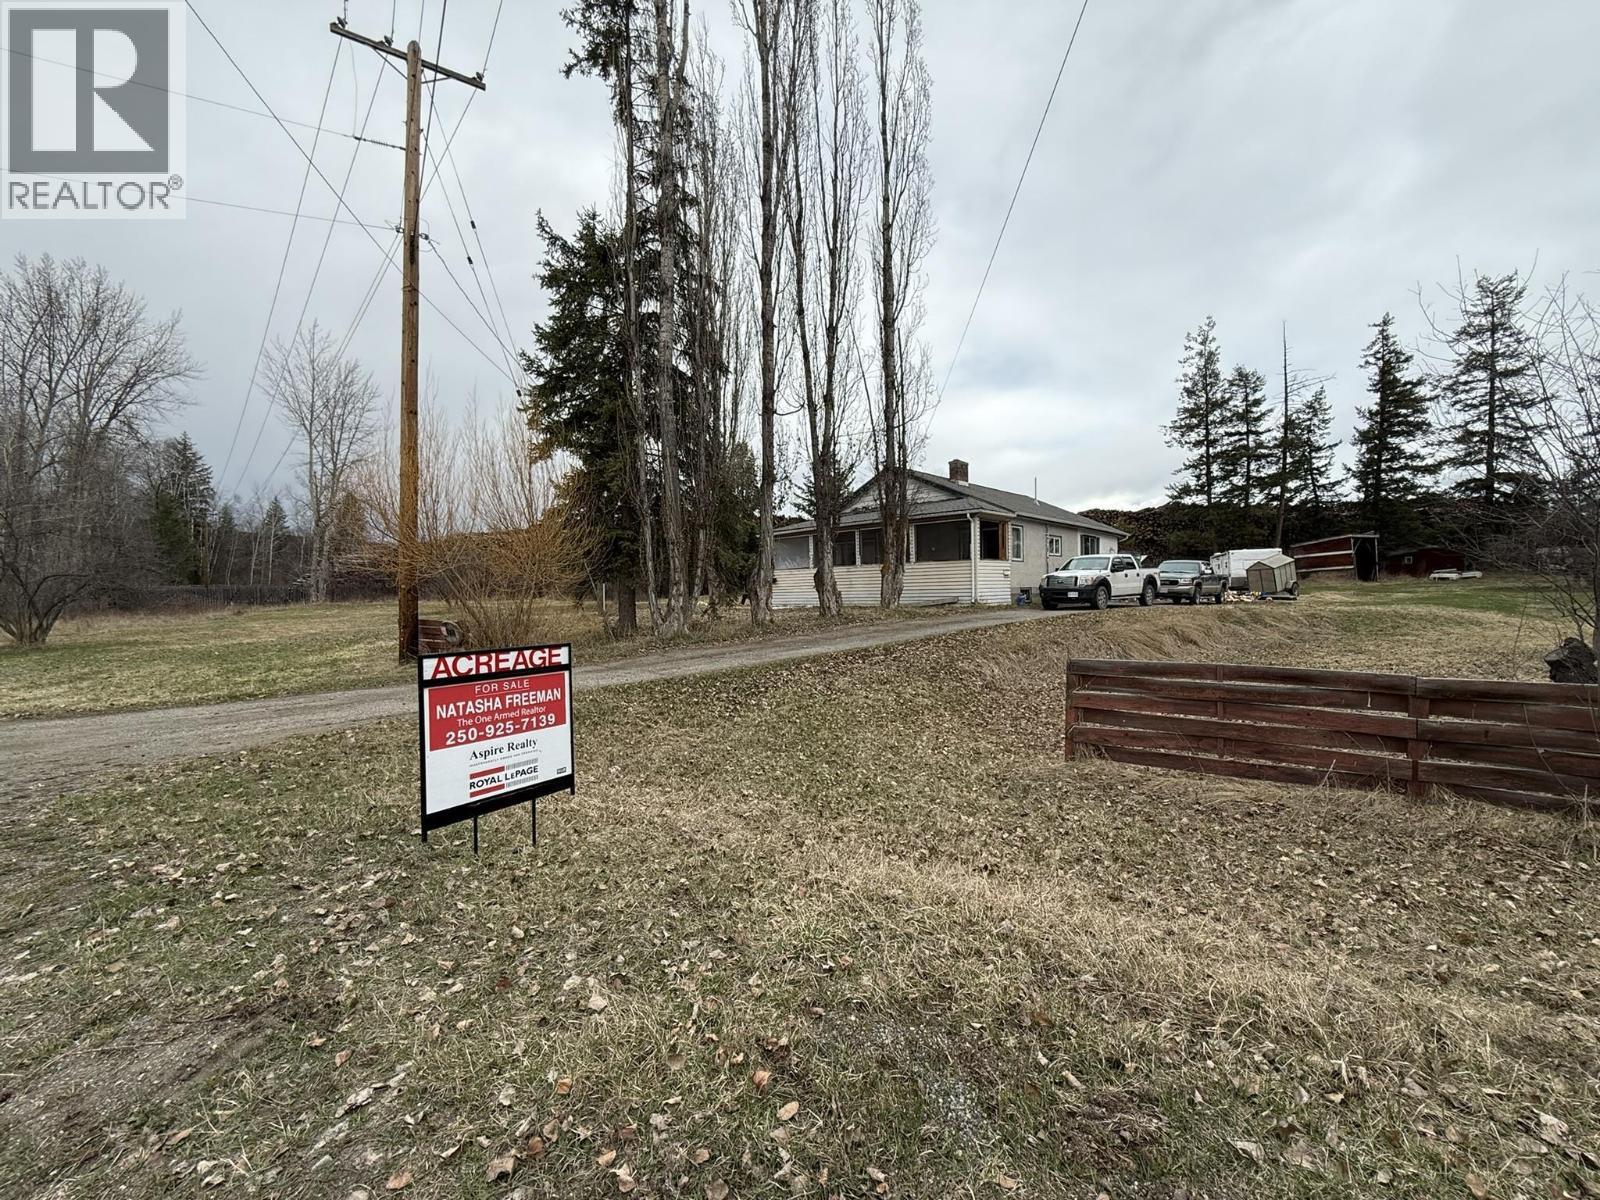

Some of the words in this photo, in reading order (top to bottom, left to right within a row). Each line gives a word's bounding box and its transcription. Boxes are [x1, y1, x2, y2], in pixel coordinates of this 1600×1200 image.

[431, 647, 562, 678] ACREAGE
[475, 683, 498, 694] FOR
[503, 679, 530, 690] SALE
[436, 697, 502, 720] NATASHA
[506, 688, 561, 708] FREEMAN
[457, 718, 473, 727] The
[474, 715, 492, 724] One
[494, 710, 519, 721] Armed
[521, 706, 546, 717] Realtor
[445, 713, 555, 745] 250-925-7139
[469, 746, 504, 760] Aspire
[508, 738, 537, 752] Realty
[469, 775, 503, 790] ROYAL
